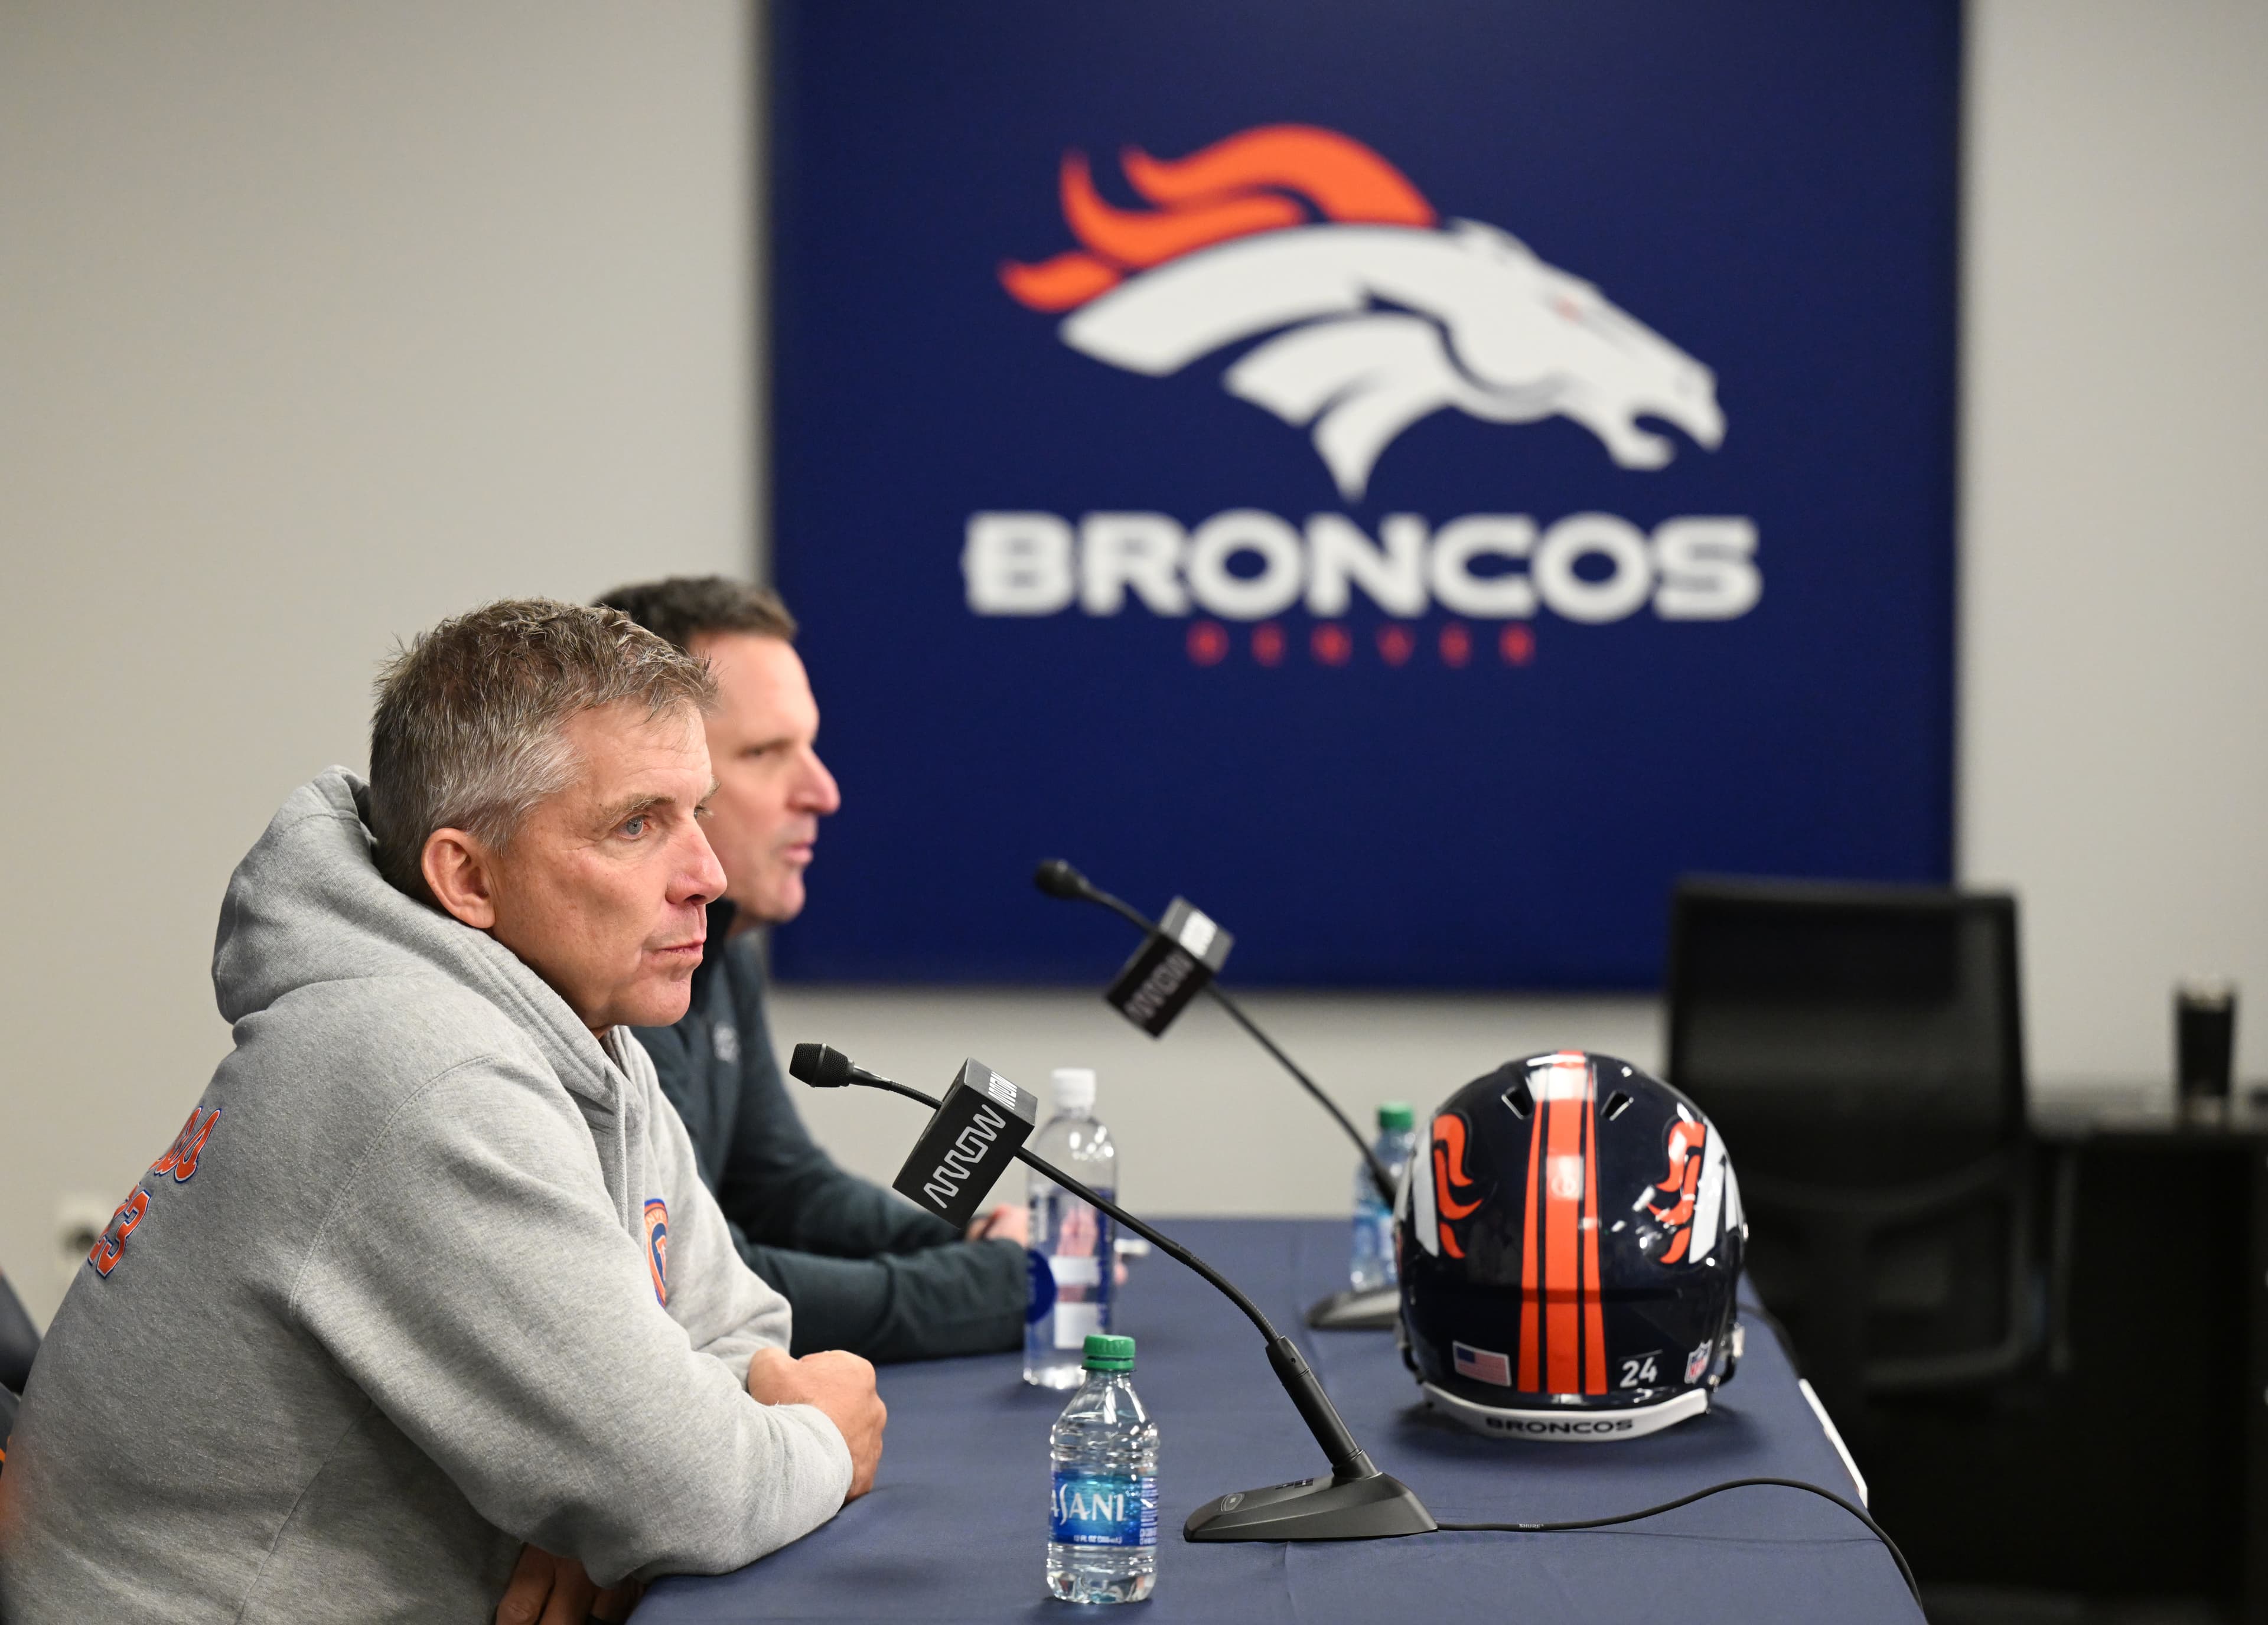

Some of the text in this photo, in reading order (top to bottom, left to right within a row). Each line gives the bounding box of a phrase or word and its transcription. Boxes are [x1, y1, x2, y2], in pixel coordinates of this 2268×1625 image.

[964, 509, 1761, 623] BRONCOS
[1619, 1356, 1657, 1388] 24
[1486, 1418, 1633, 1434] BRONCOS
[1050, 1483, 1126, 1526] ASANI
